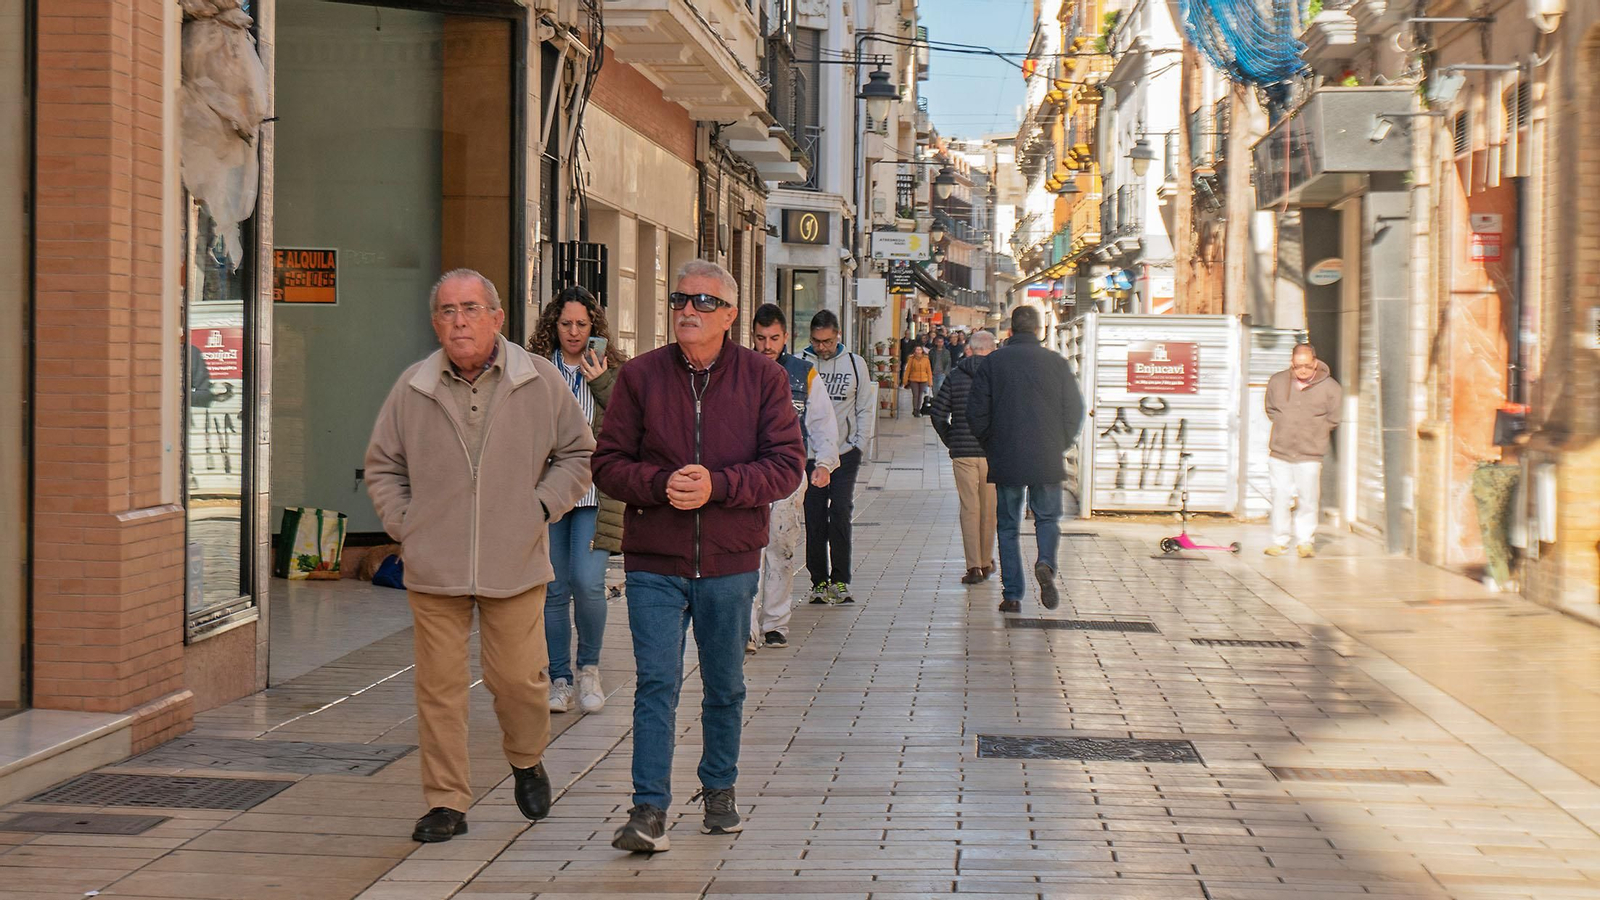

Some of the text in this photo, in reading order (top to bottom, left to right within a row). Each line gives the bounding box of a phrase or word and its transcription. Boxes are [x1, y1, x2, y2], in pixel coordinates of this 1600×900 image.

[286, 251, 336, 269] ALQUILA
[1135, 363, 1185, 376] Enjucavi
[819, 373, 852, 384] PURE
